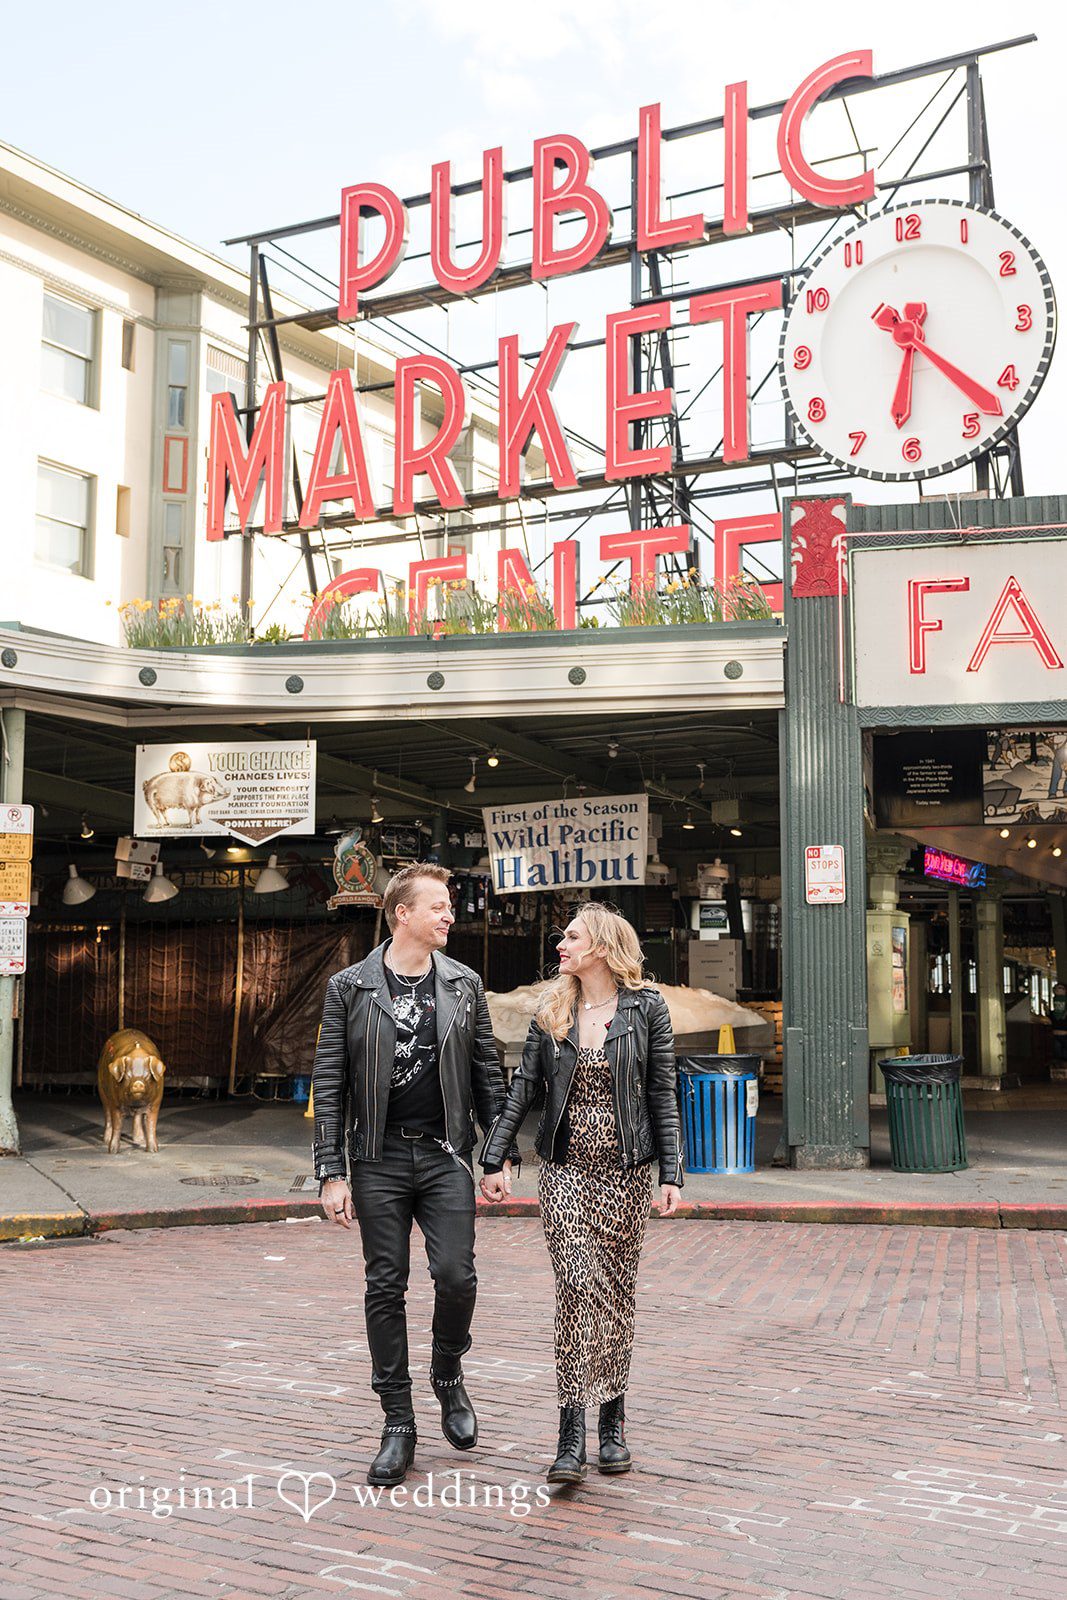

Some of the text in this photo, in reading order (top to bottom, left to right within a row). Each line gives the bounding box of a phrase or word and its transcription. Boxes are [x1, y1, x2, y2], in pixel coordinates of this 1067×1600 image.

[338, 48, 876, 321] PUBLIC
[896, 213, 921, 241] 12
[960, 218, 968, 244] 1
[844, 240, 864, 267] 11
[998, 250, 1016, 276] 2
[806, 287, 830, 314] 10
[1014, 304, 1032, 332] 3
[793, 345, 812, 370] 9
[997, 364, 1019, 391] 4
[206, 280, 784, 542] MARKET
[807, 396, 826, 423] 8
[962, 412, 980, 439] 5
[848, 430, 867, 456] 7
[902, 437, 922, 463] 6
[907, 575, 1065, 674] FA
[208, 750, 311, 772] YOUR CHANGE
[224, 772, 310, 781] CHANGES LIVES!
[491, 801, 639, 825] First of the Season
[492, 825, 551, 850] Wild
[558, 819, 640, 845] Pacific
[808, 849, 819, 857] NO
[811, 860, 839, 869] STOPS
[494, 847, 640, 890] Halibut
